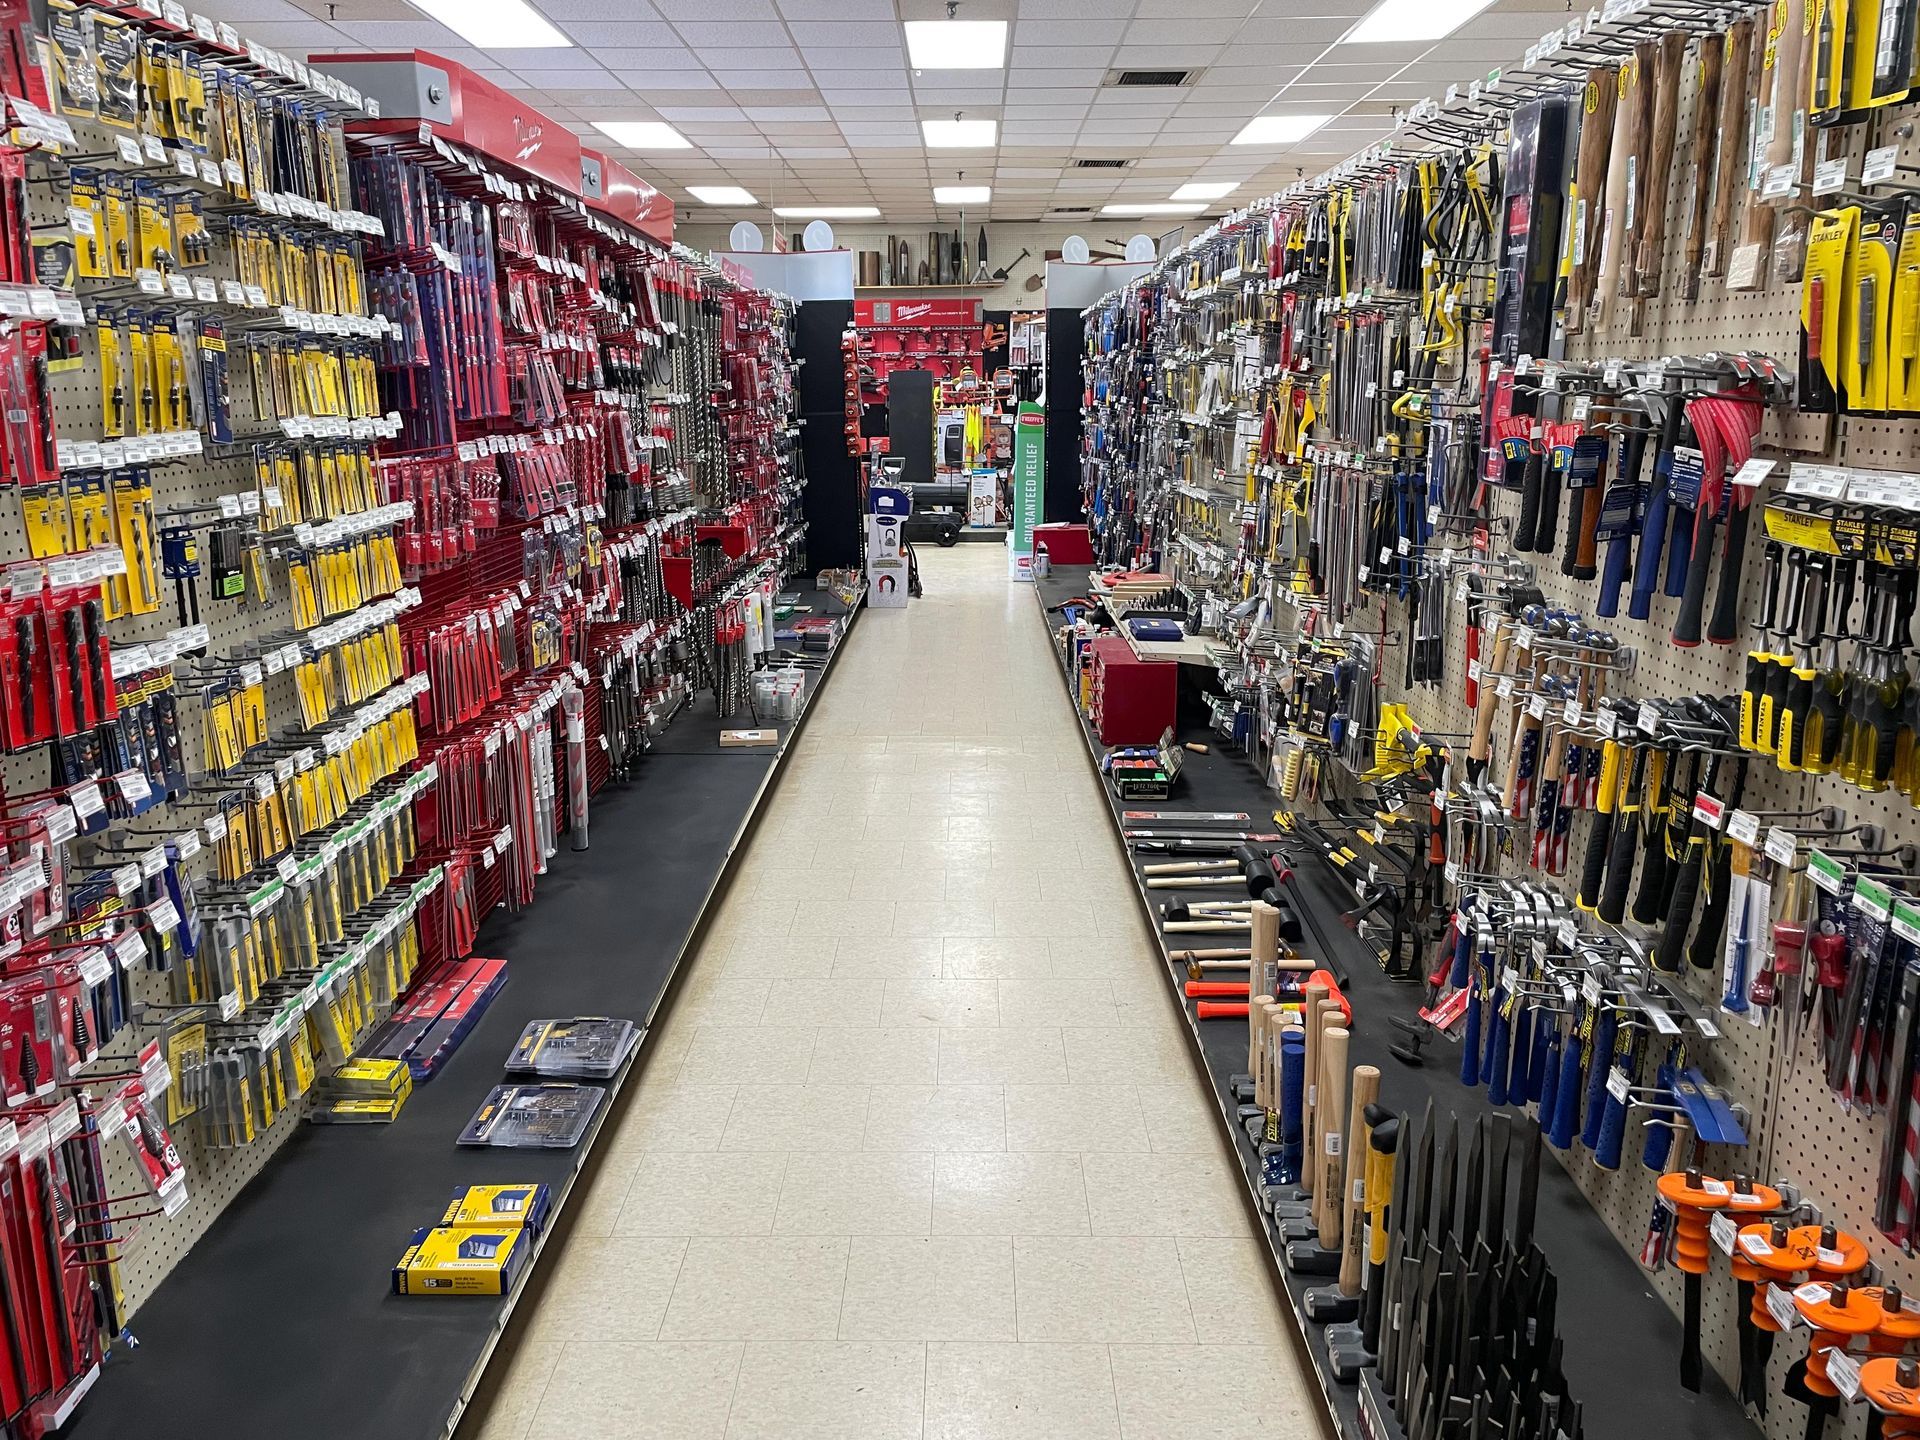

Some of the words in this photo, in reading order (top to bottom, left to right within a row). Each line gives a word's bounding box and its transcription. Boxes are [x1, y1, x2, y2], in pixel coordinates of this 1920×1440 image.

[72, 183, 98, 195] IRWIN
[1811, 230, 1844, 245] STANLEY
[896, 303, 932, 317] Milwaukee
[1026, 443, 1037, 477] RELIEF
[1024, 481, 1036, 543] GUARANTEED
[1784, 512, 1815, 528] STANLEY
[1836, 519, 1866, 530] STANLEY
[1890, 527, 1918, 538] STANLEY
[411, 541, 421, 549] 10
[431, 538, 442, 547] 10
[1758, 702, 1767, 740] STANLEY
[1778, 717, 1787, 756] STANLEY
[1268, 1111, 1277, 1139] ESTWING
[440, 1198, 463, 1223] IRWIN
[396, 1244, 420, 1270] IRWIN
[399, 1272, 407, 1294] IRWIN
[423, 1278, 438, 1288] 15
